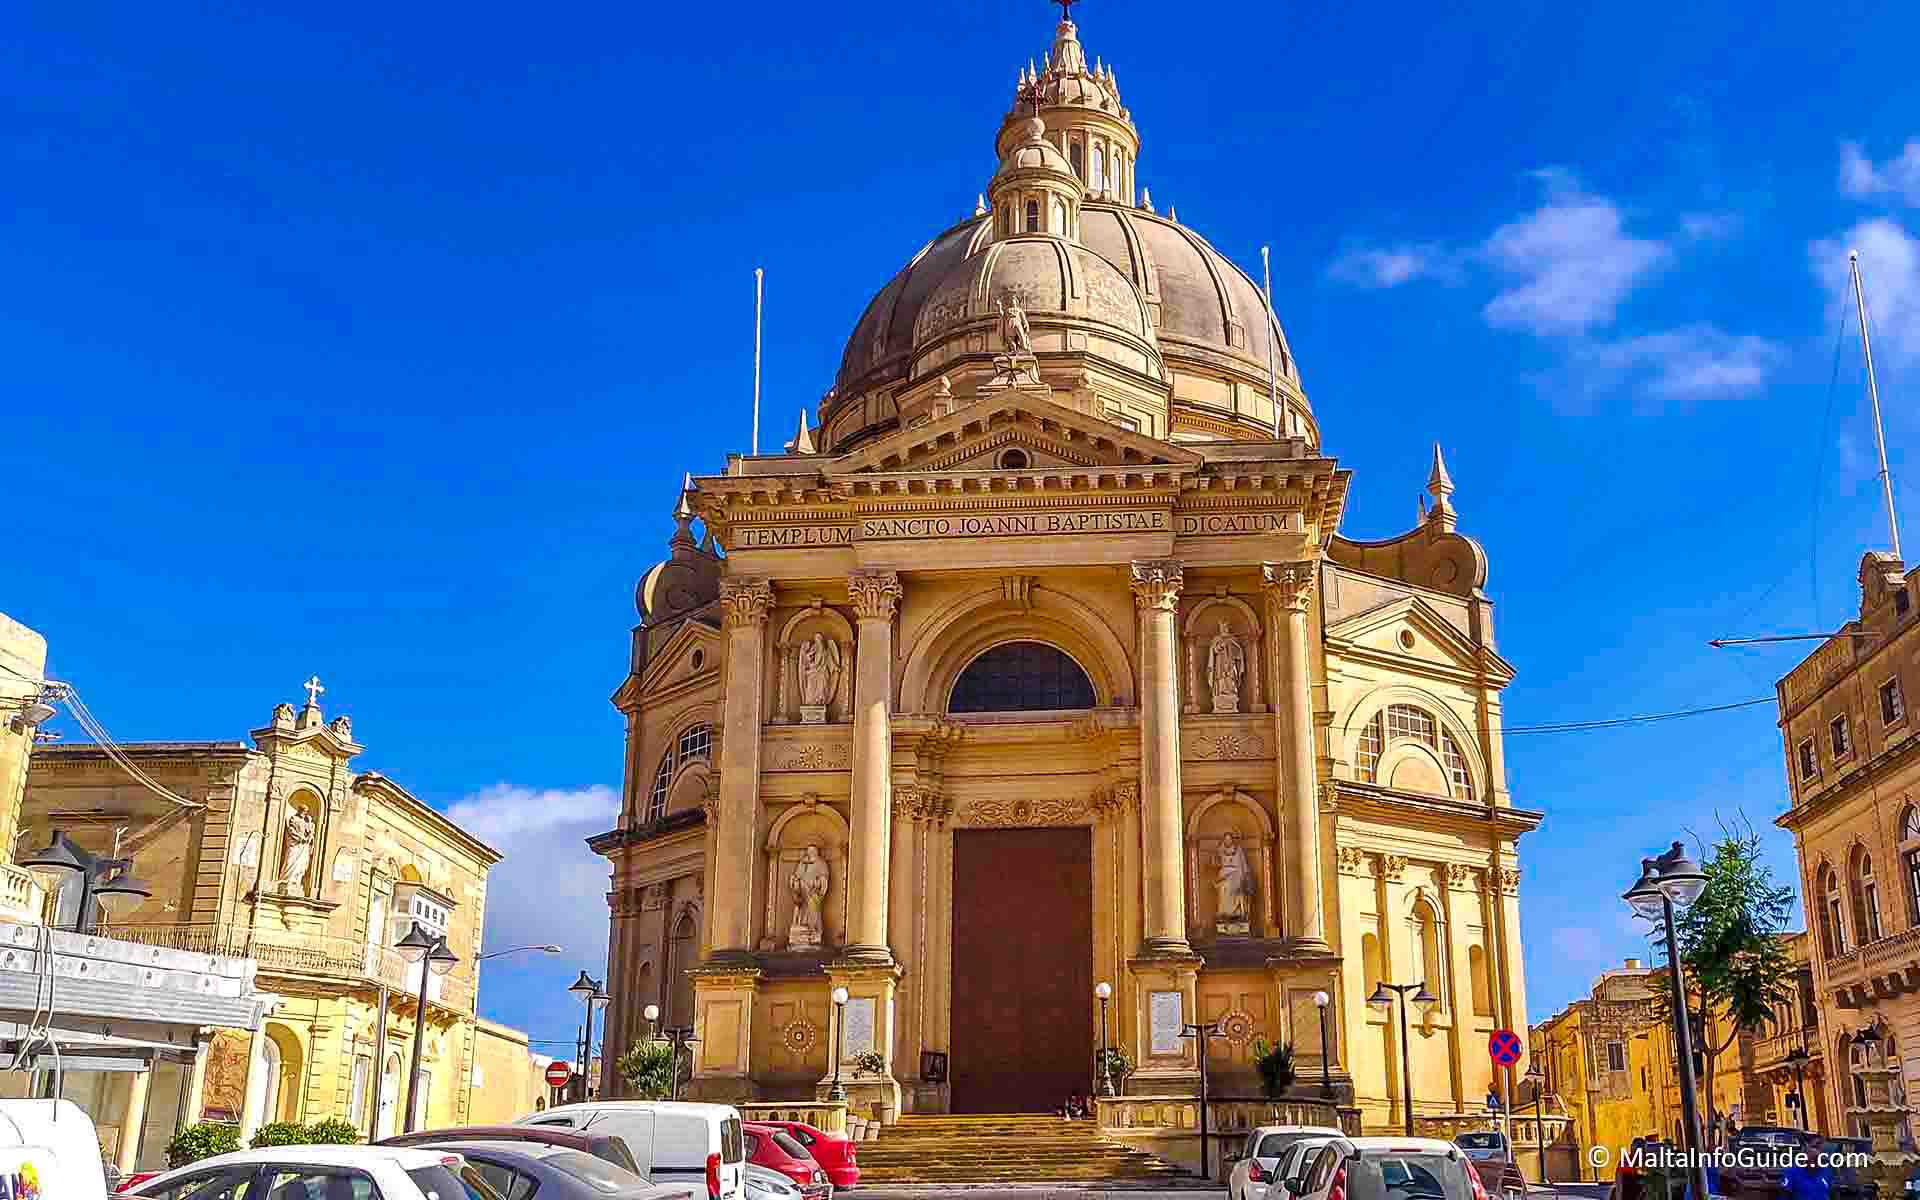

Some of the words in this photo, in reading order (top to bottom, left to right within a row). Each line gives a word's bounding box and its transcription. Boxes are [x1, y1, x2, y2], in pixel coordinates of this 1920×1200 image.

[743, 526, 852, 546] TEMPLUM
[865, 519, 950, 537] SANCTO
[958, 516, 1037, 535] JOANNI
[1047, 513, 1164, 531] BAPTISTAE
[1183, 515, 1289, 533] DICATUM
